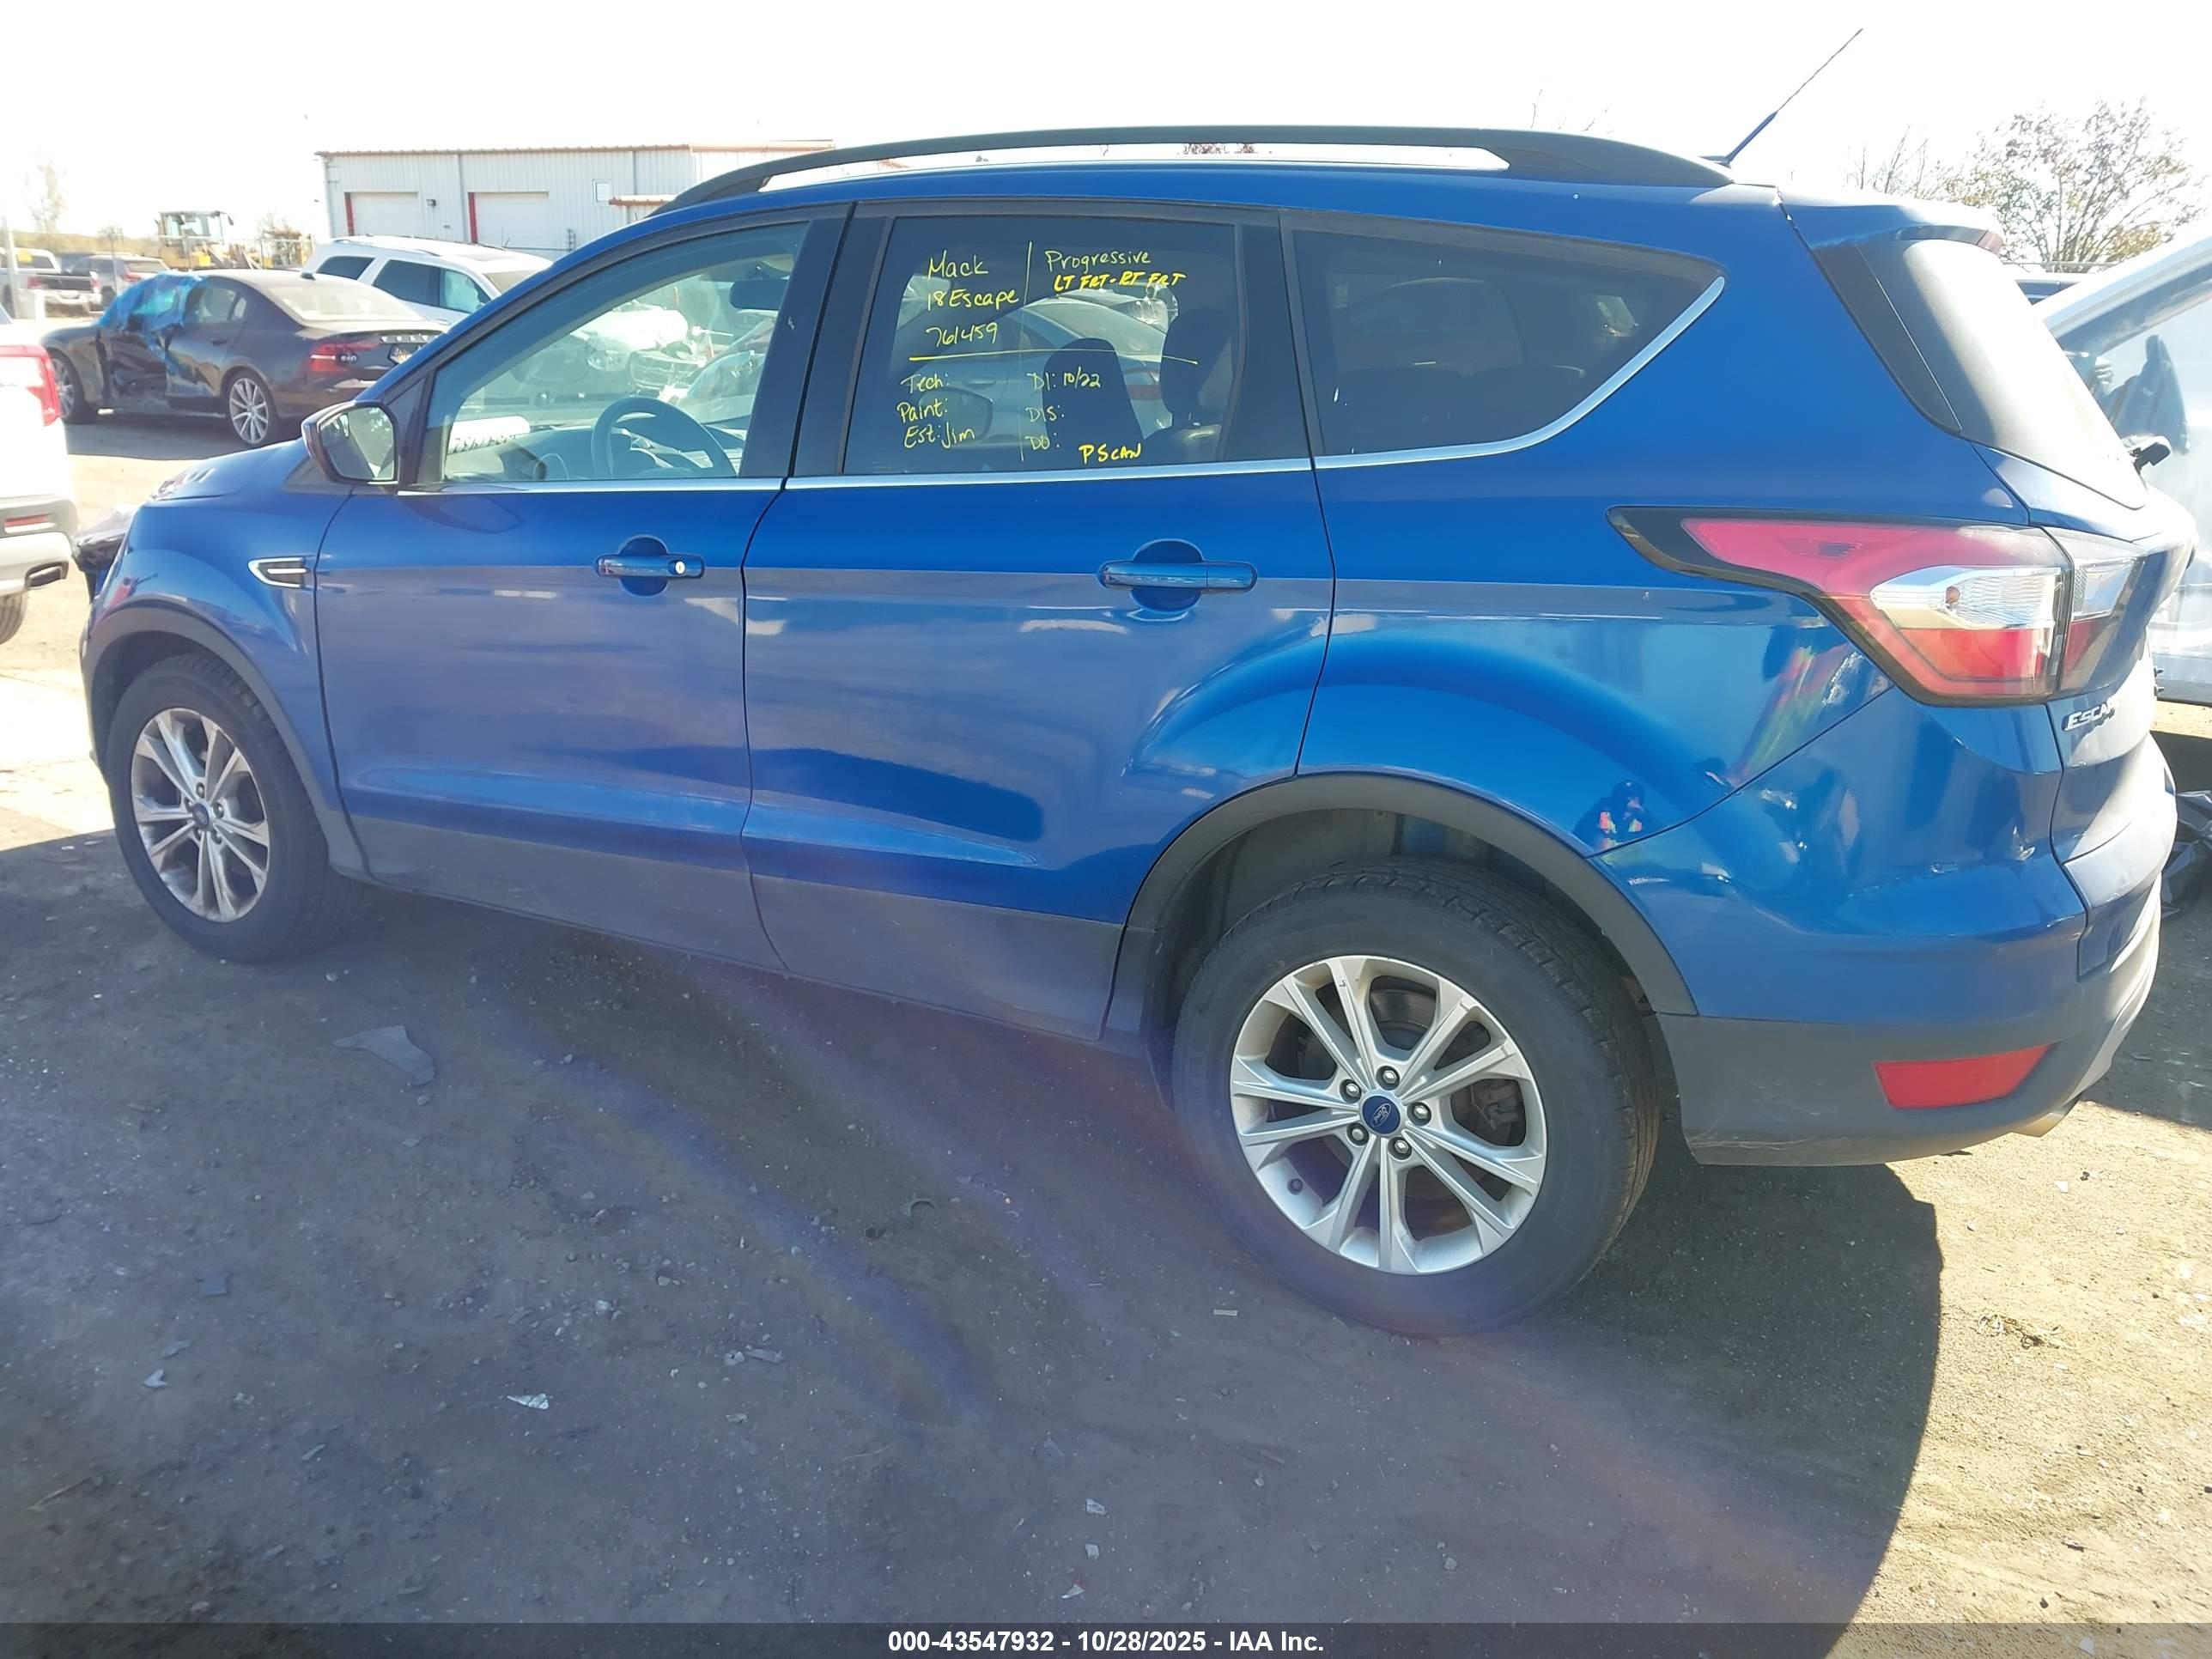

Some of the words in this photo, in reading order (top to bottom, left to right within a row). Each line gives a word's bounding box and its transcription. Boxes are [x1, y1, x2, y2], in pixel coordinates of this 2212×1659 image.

[927, 249, 989, 281] Mack
[1044, 250, 1152, 273] Progressive
[1053, 275, 1076, 292] LT
[925, 322, 998, 348] 761459
[900, 373, 951, 393] Tech:
[1063, 366, 1101, 389] 10/22
[896, 397, 948, 423] Paint:
